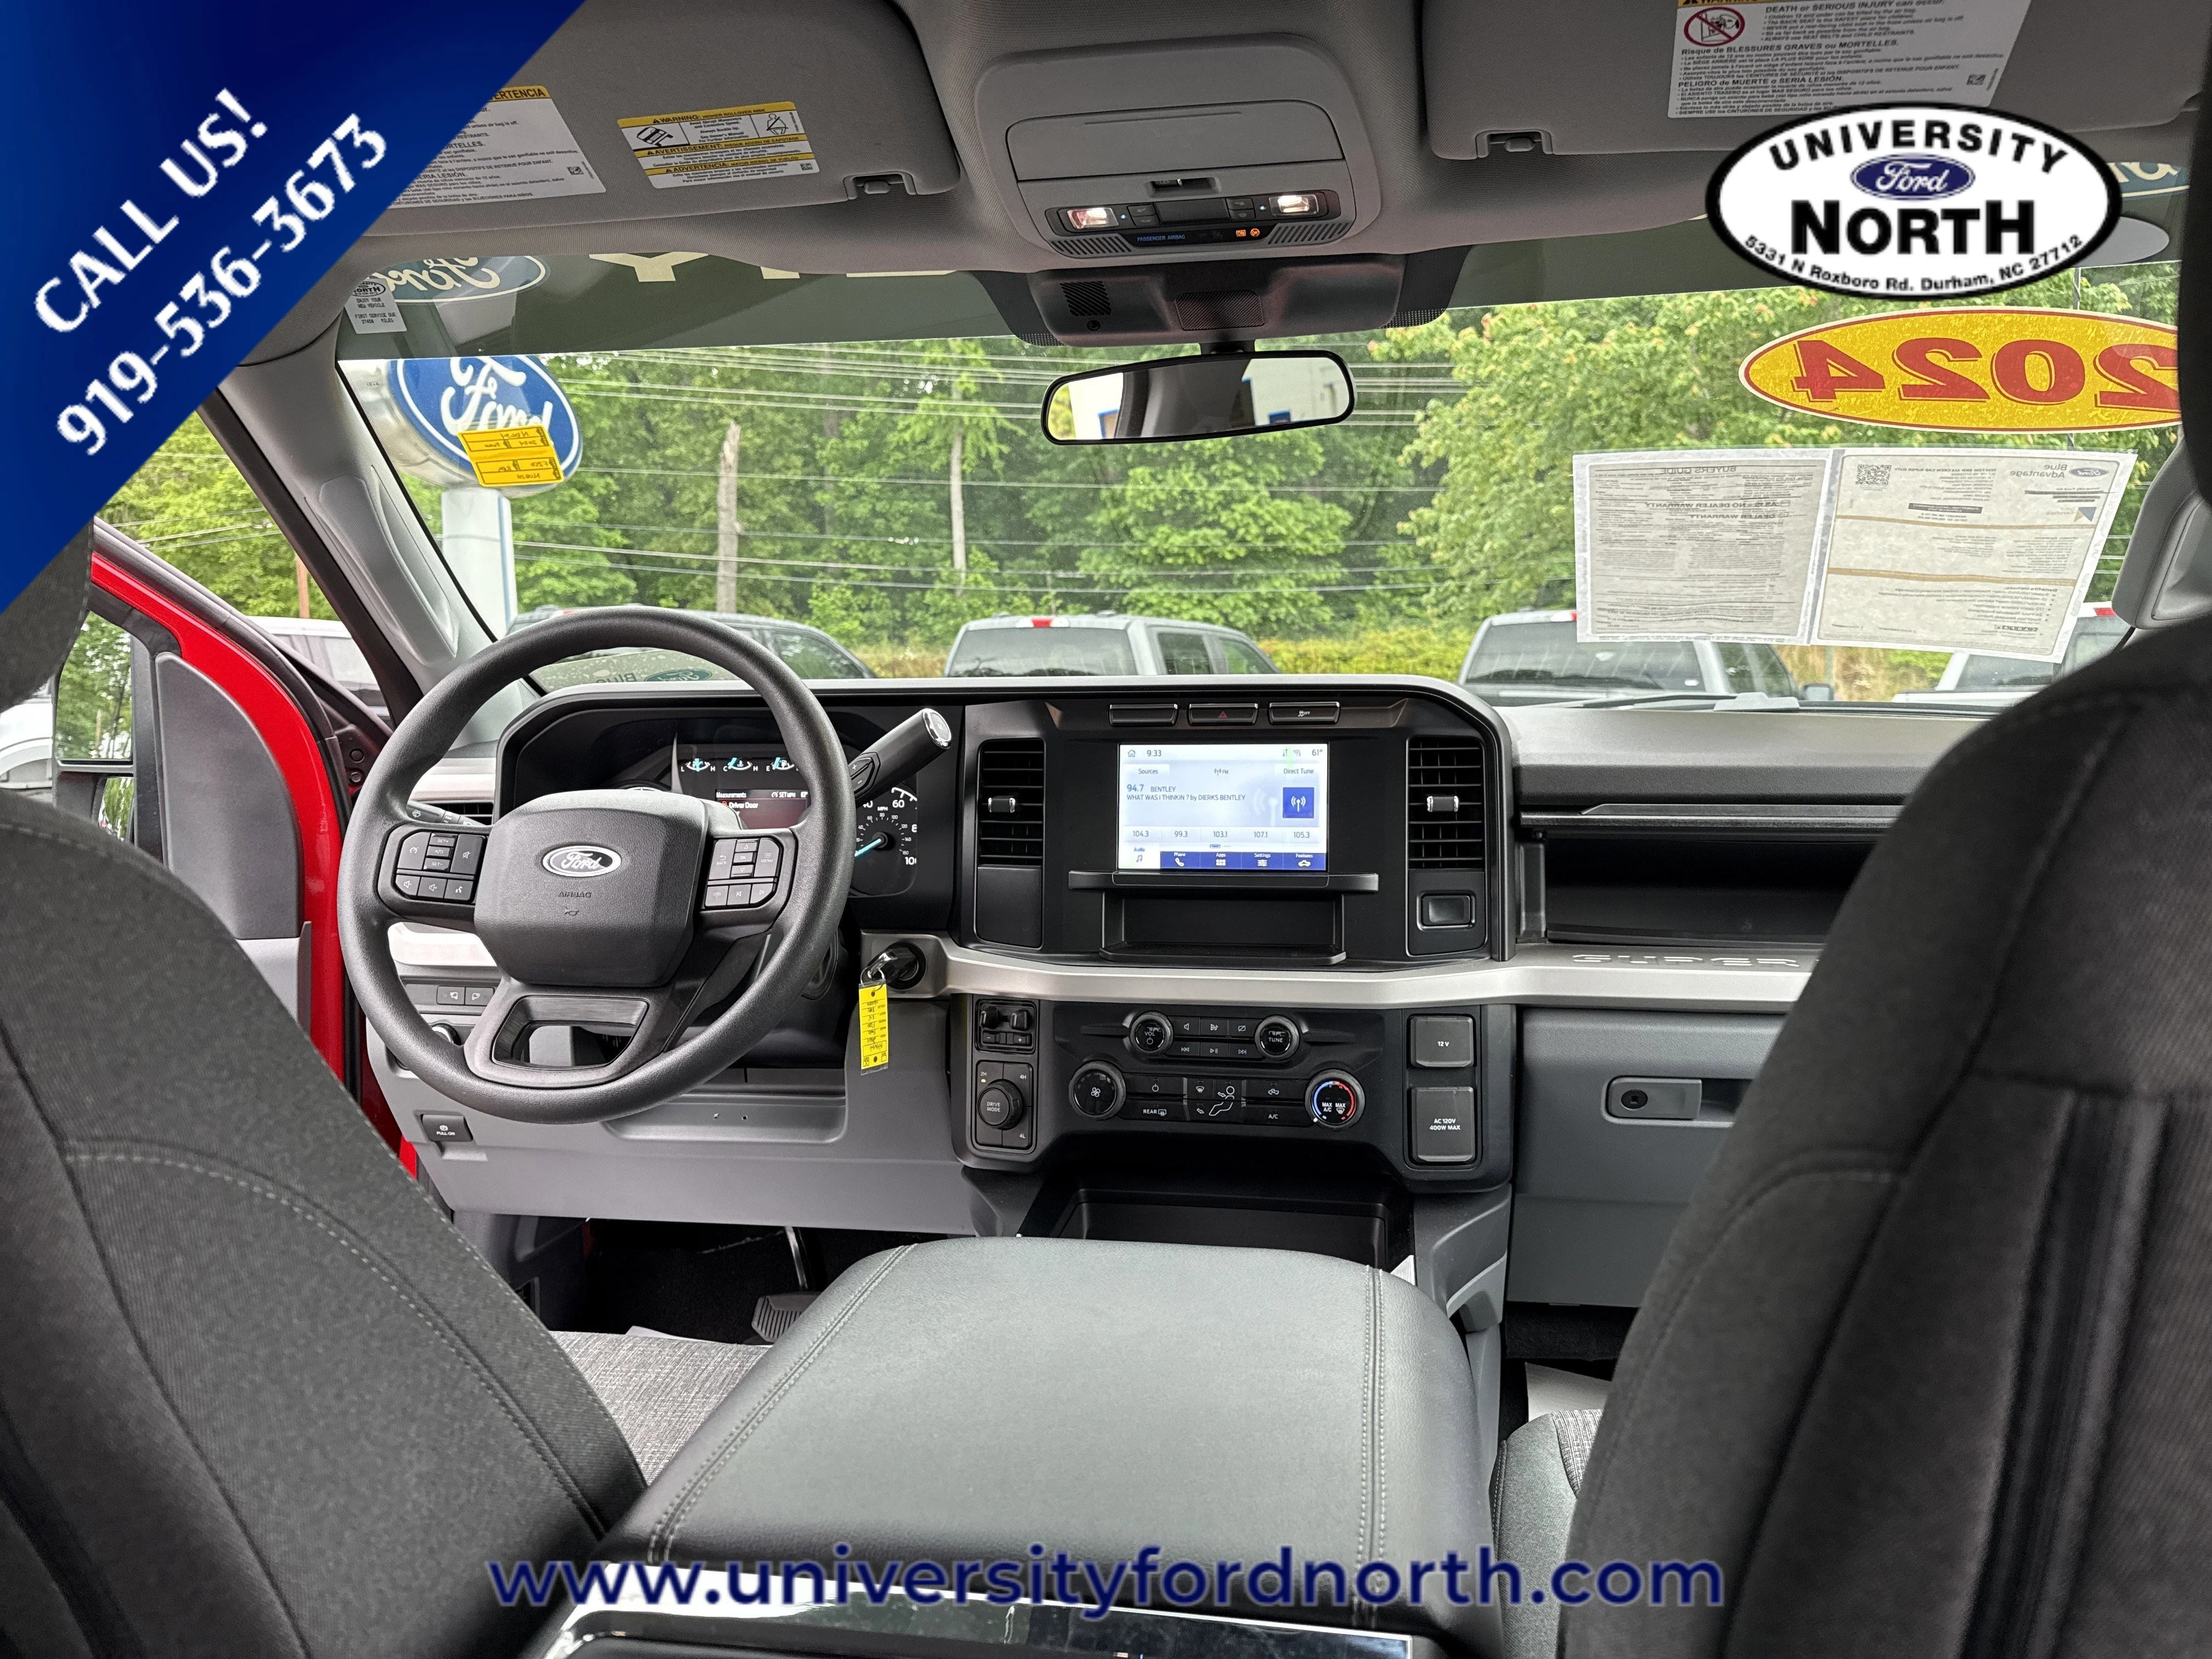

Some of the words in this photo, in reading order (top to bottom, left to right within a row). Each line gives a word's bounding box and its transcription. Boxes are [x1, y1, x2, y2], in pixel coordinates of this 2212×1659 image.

[1812, 2, 1856, 11] SERIOUS
[1726, 44, 1782, 53] BLESSURES
[492, 88, 546, 100] ERTENCIA
[659, 114, 701, 123] WARNING:
[891, 799, 905, 808] 60
[561, 851, 602, 870] Ford
[1572, 954, 1800, 968] SUPER
